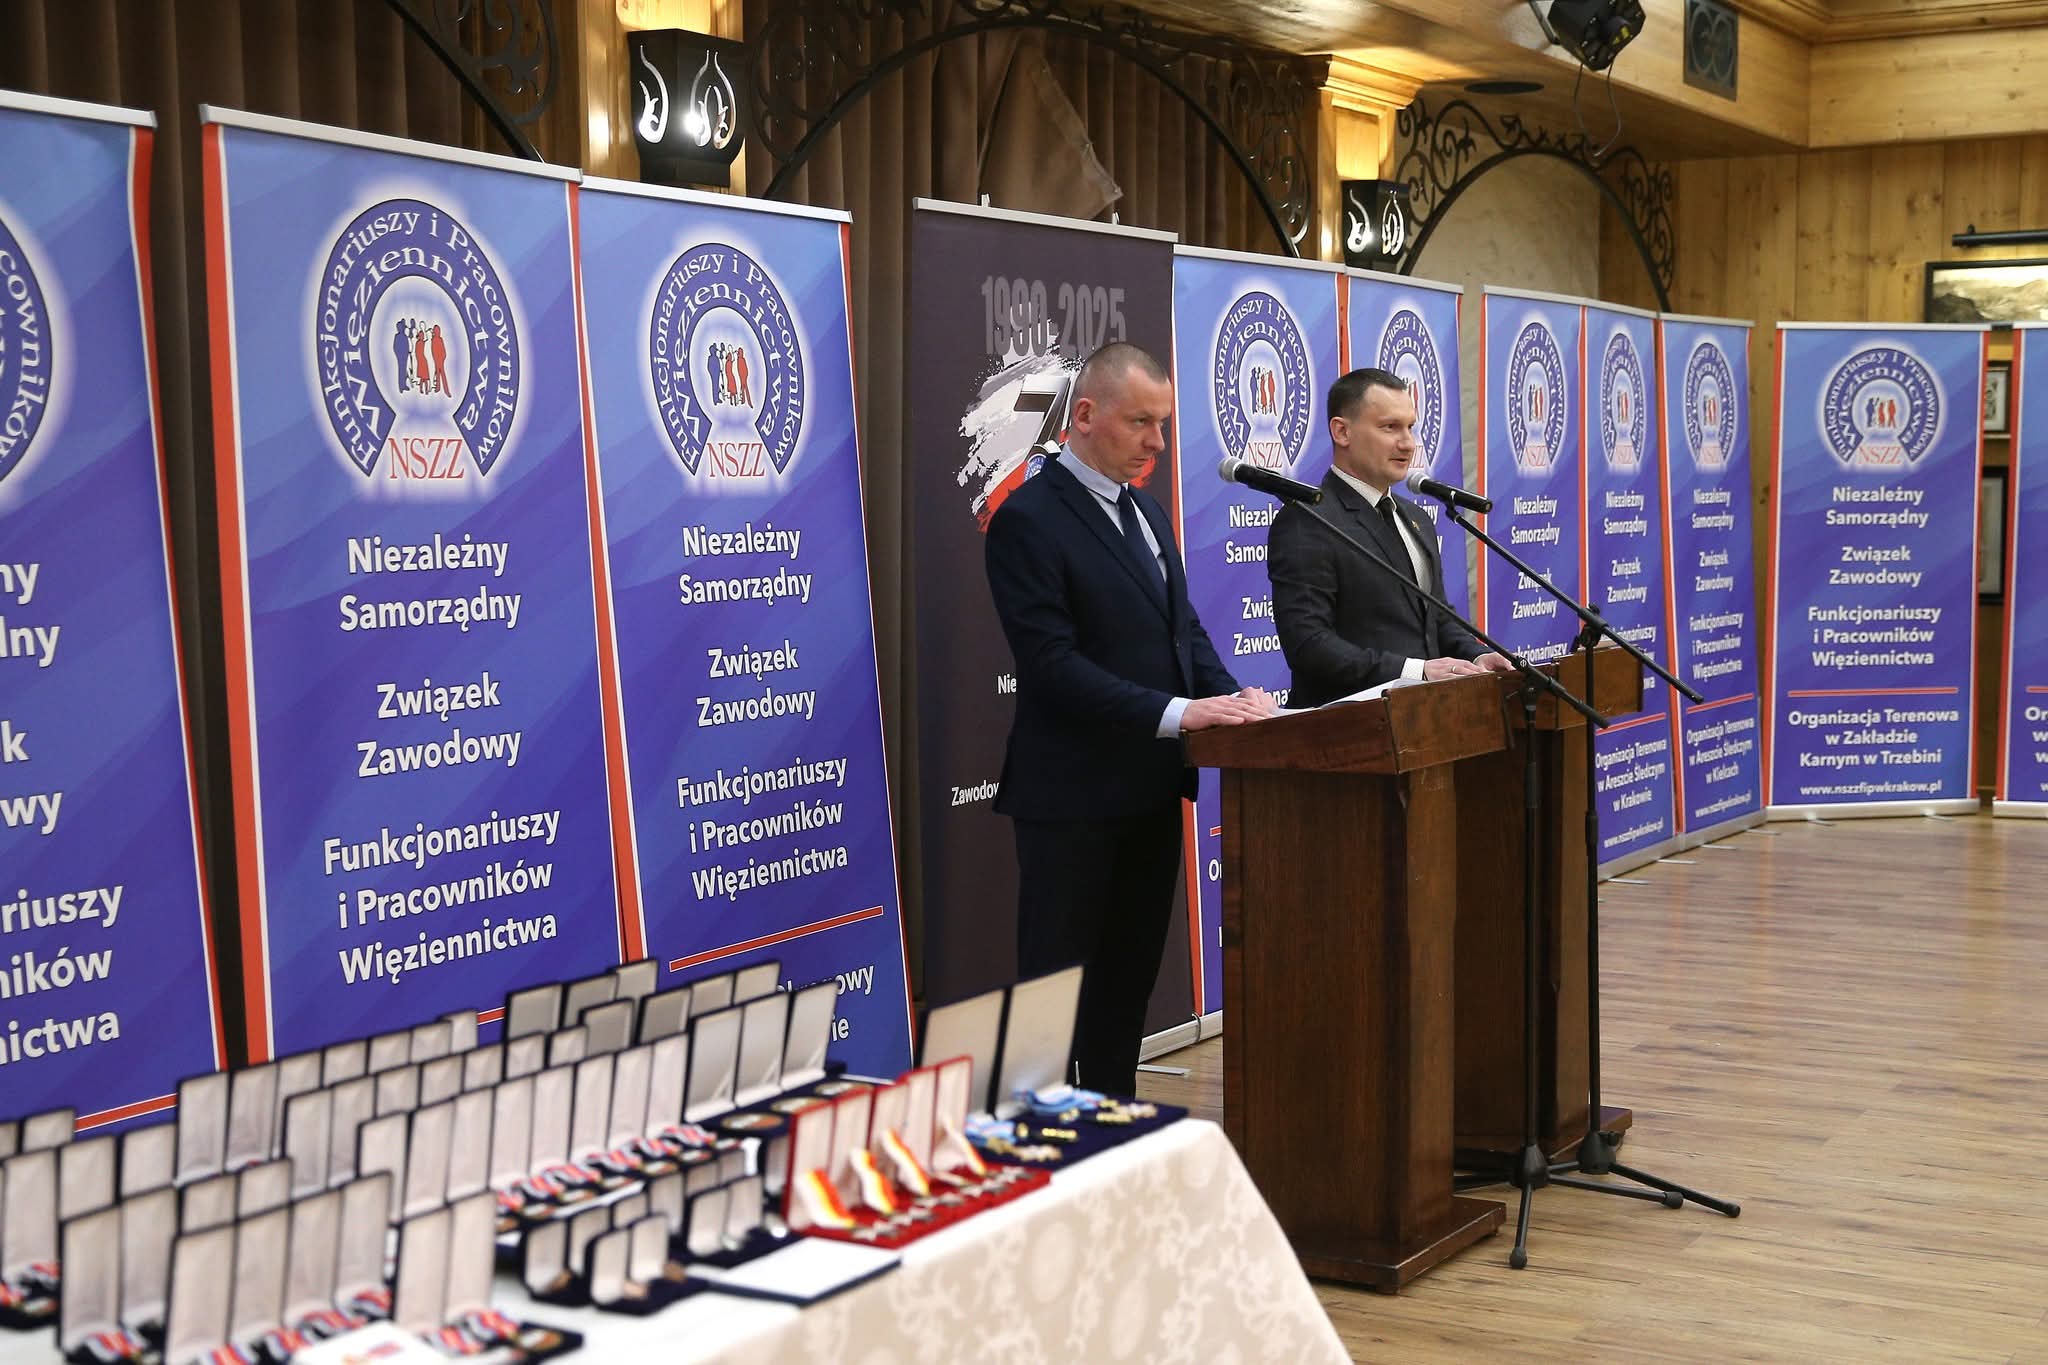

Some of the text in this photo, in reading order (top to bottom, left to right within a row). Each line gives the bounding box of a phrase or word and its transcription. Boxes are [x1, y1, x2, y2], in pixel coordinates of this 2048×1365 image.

[1267, 299, 1272, 315] i
[320, 212, 515, 469] Funkcjonariuszy i Pracowników
[344, 247, 489, 440] Więziennictwa
[653, 253, 801, 469] Funkcjonariuszy i Pracowników
[388, 437, 464, 479] NSZZ
[706, 442, 765, 477] NSZZ
[1513, 494, 1557, 518] Niezależny
[1832, 486, 1924, 506] Niezależny
[1511, 521, 1560, 546] Samorządny
[1826, 509, 1929, 529] Samorządny
[347, 533, 509, 577] Niezależny
[682, 522, 801, 559] Niezależny
[1841, 545, 1911, 565] Związek
[679, 566, 812, 606] Samorządny
[1829, 568, 1922, 587] Zawodowy
[339, 585, 521, 632] Samorządny
[1241, 594, 1275, 623] Zwią
[1512, 596, 1557, 619] Zawodowy
[1808, 605, 1942, 625] Funkcjonariuszy
[1813, 626, 1935, 644] i Pracowników
[707, 639, 799, 681] Związek
[1812, 650, 1935, 670] Więziennictwa
[376, 671, 501, 722] Związek
[696, 687, 815, 727] Zawodowy
[1788, 708, 1959, 729] Organizacja Terenowa
[1825, 728, 1918, 745] w Zakładzie
[357, 728, 522, 777] Zawodowy
[1800, 748, 1942, 770] Karnym w Trzebini
[677, 757, 847, 808] Funkcjonariuszy
[323, 810, 560, 875] Funkcjonariuszy
[689, 799, 843, 854] i Pracowników
[691, 845, 848, 901] Więziennictwa
[338, 859, 553, 929] i Pracowników
[338, 913, 557, 985] Więziennictwa
